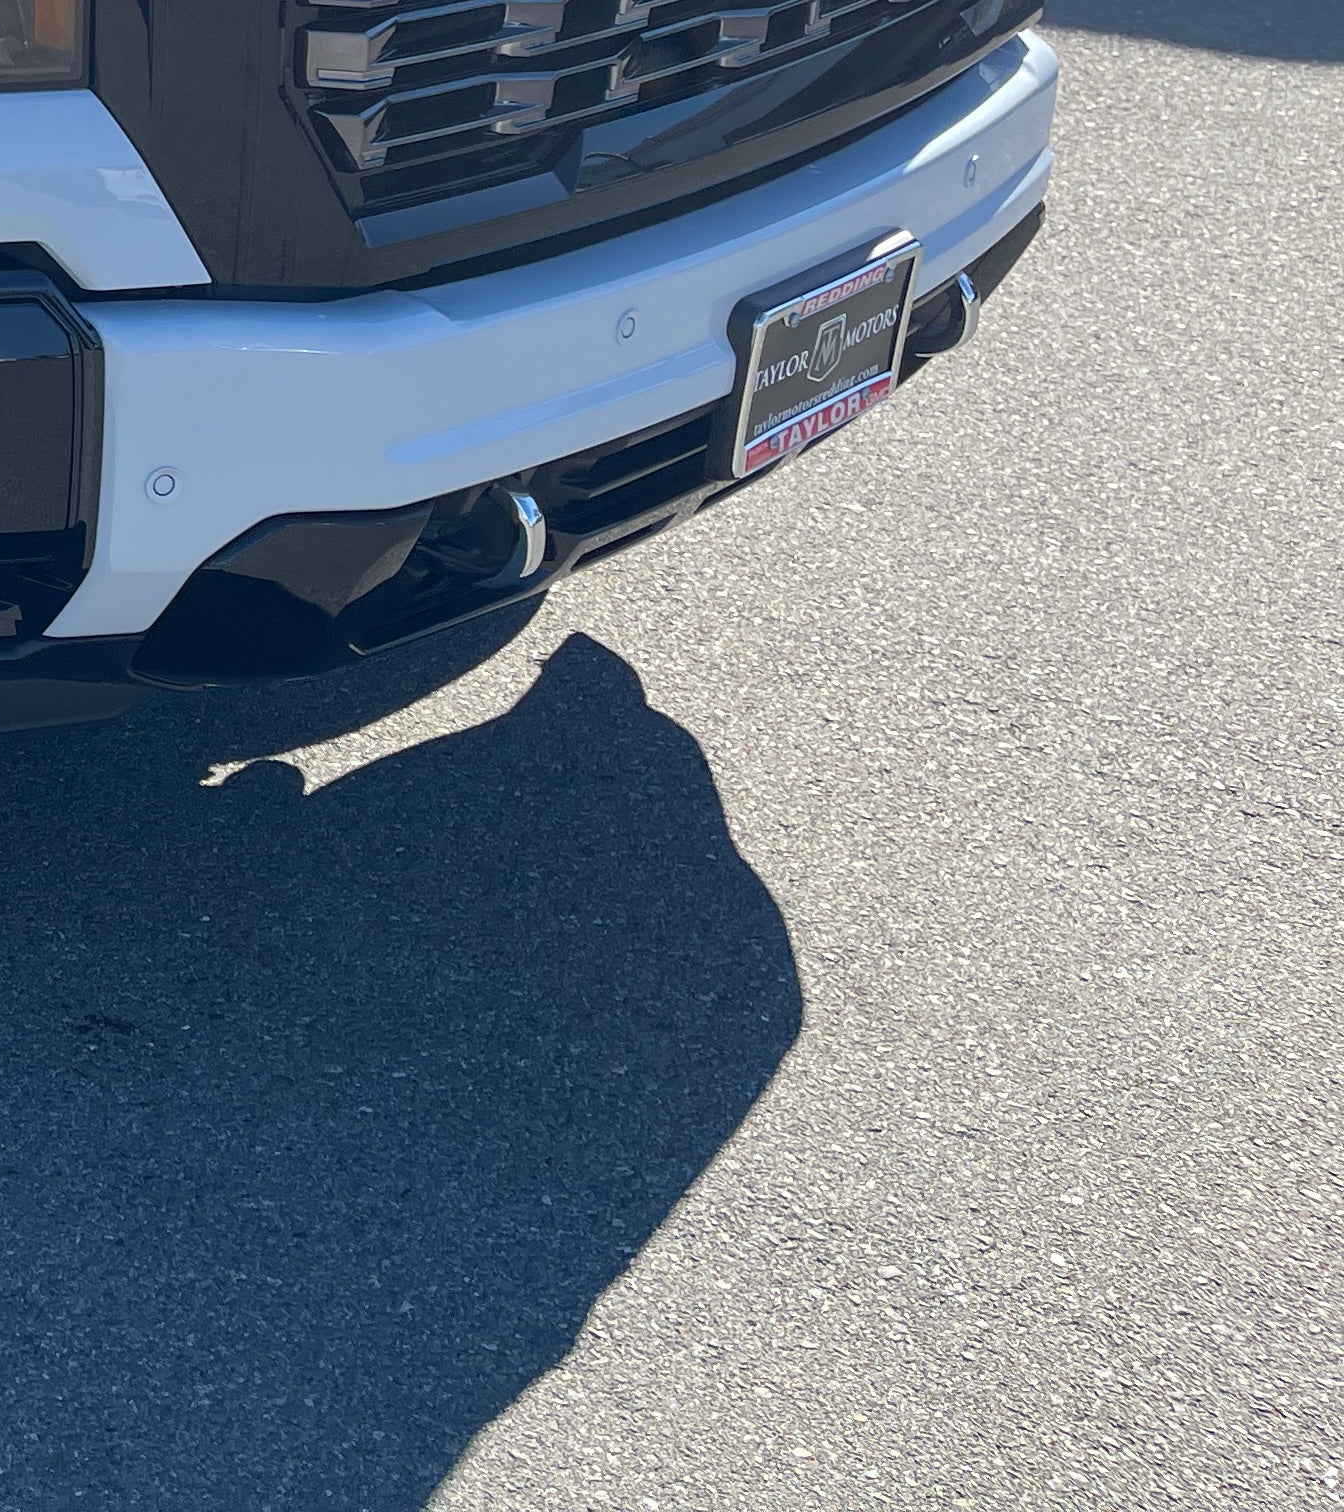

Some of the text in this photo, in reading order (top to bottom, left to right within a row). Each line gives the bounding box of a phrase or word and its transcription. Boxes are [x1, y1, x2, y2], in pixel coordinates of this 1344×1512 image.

[802, 266, 886, 316] REDDING
[752, 350, 809, 393] TAYLOR
[842, 303, 900, 351] MOTORS
[753, 363, 879, 437] taylormotorsredding.com
[776, 392, 861, 453] TAYLOR
